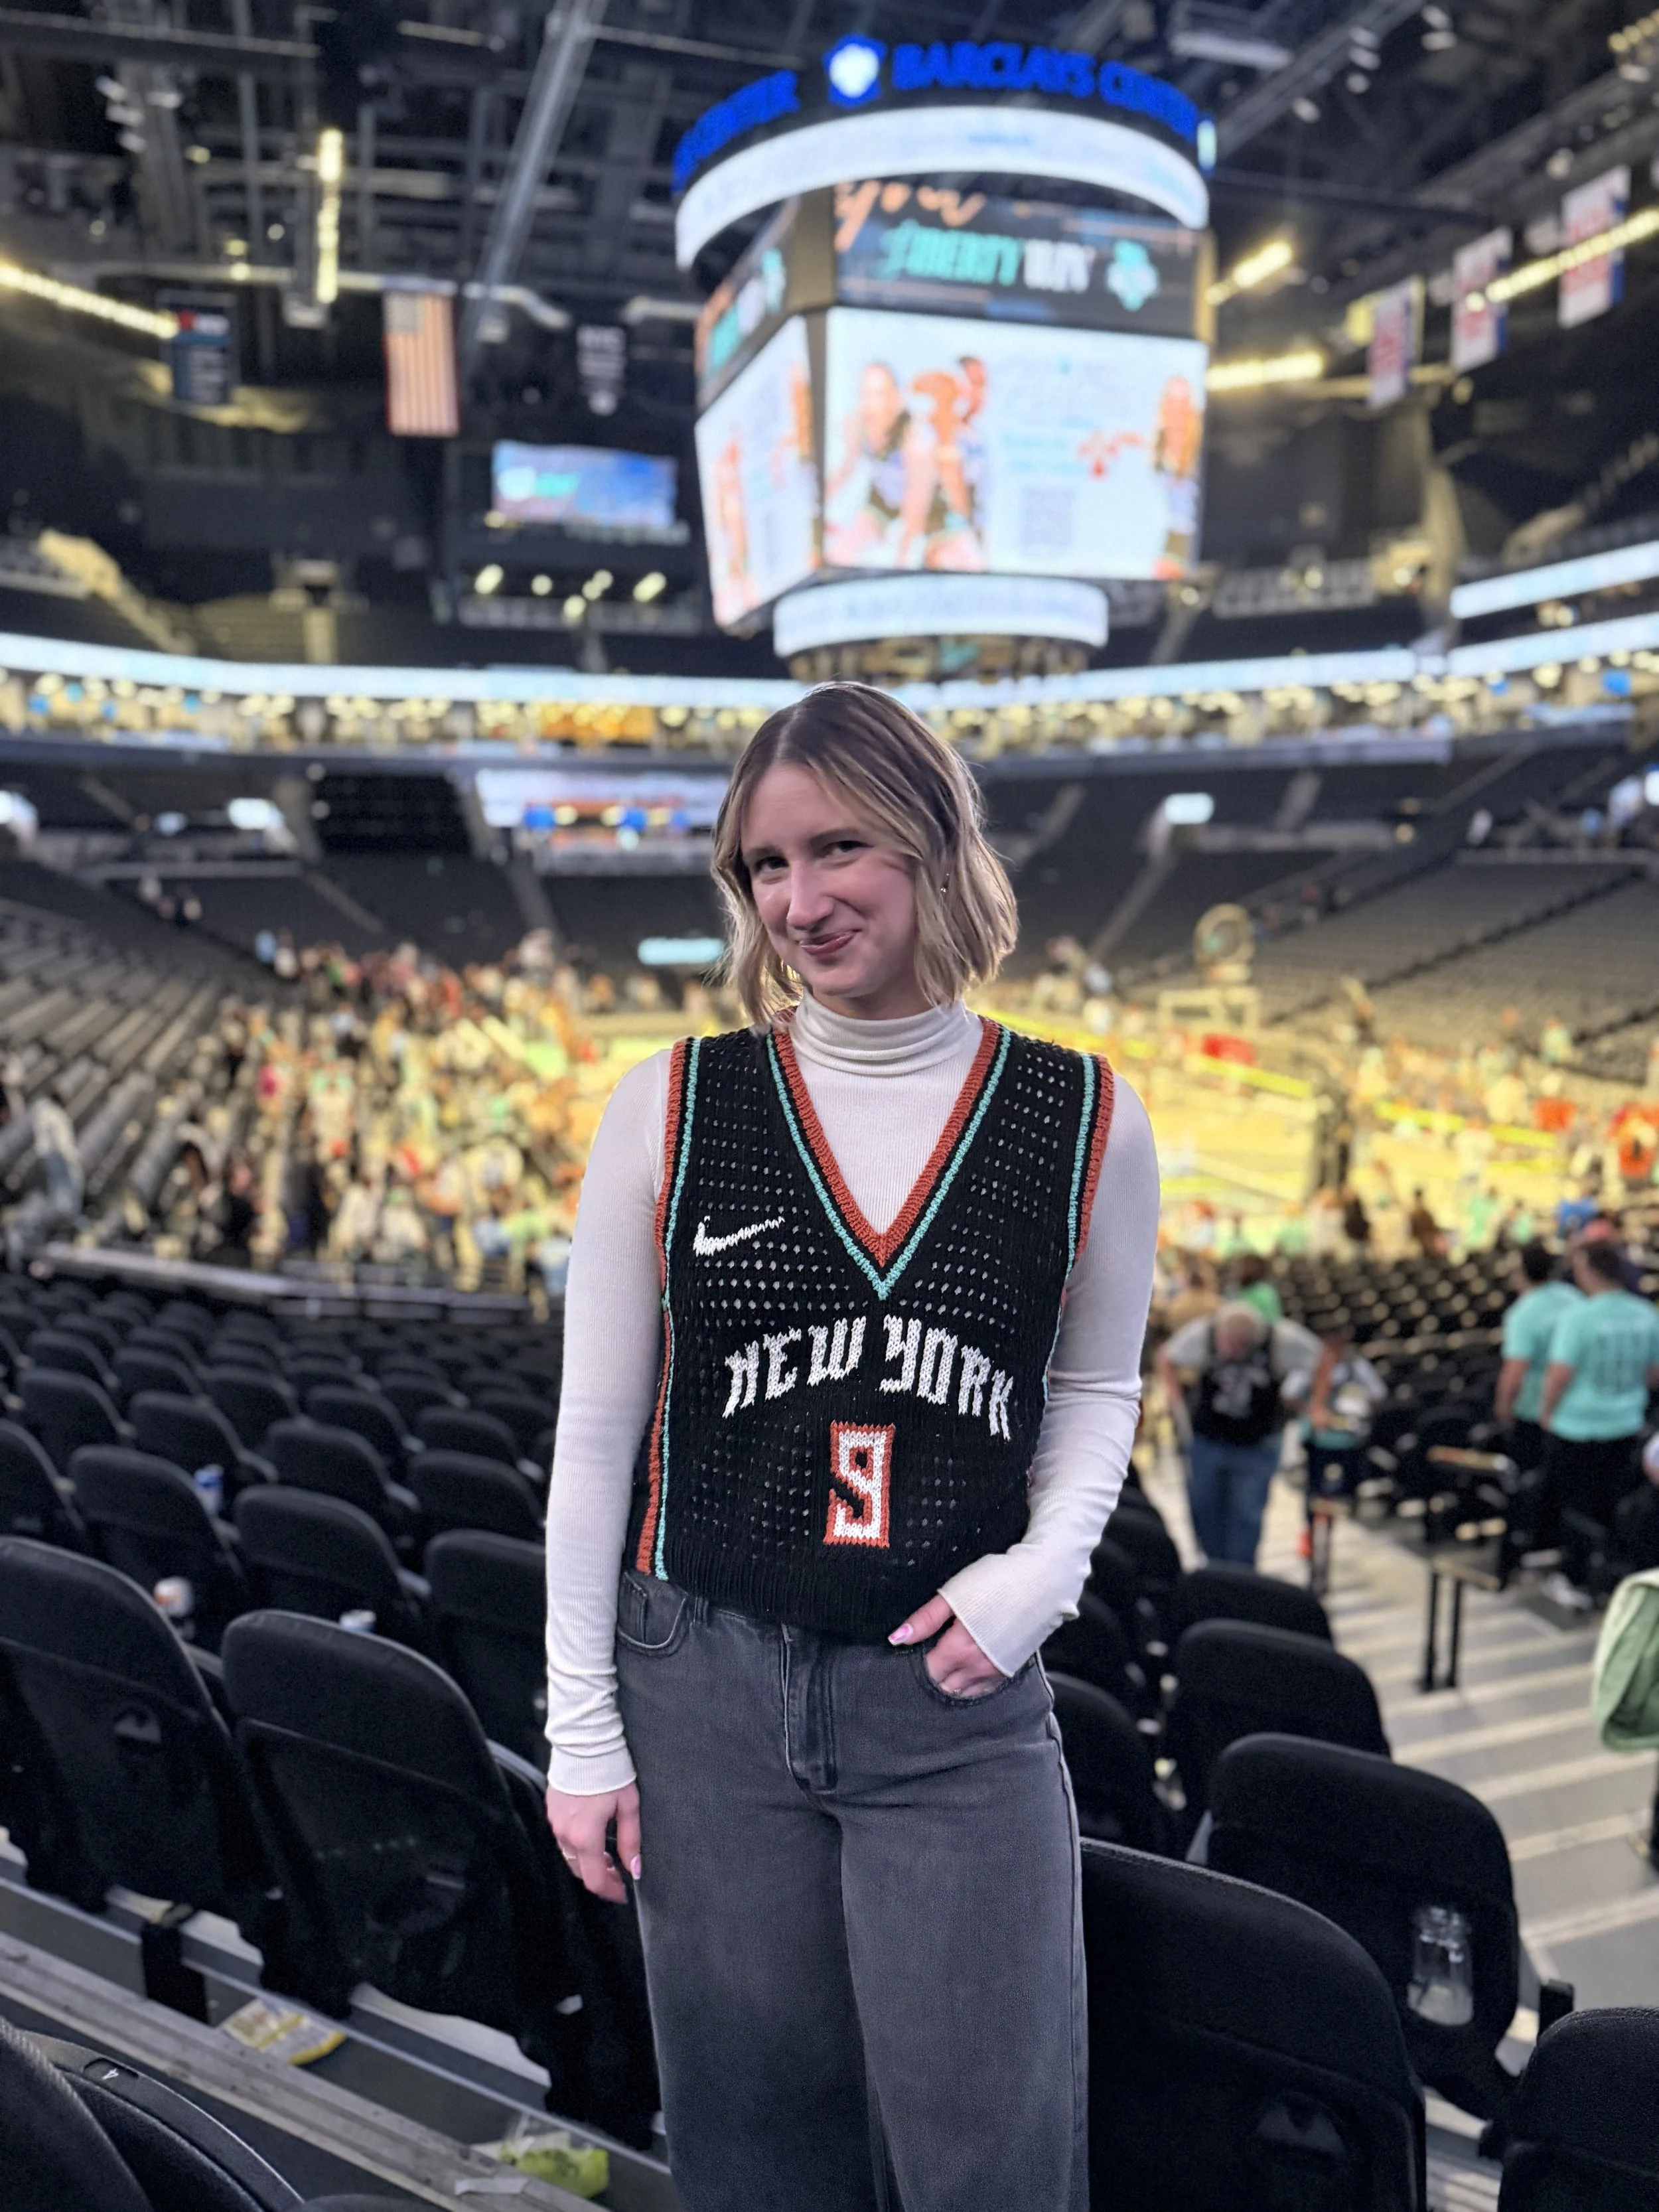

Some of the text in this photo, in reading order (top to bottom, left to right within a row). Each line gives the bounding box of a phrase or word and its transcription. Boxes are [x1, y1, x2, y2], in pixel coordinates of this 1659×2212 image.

[722, 1313, 1014, 1441] NEW YORK
[824, 1420, 895, 1548] 9
